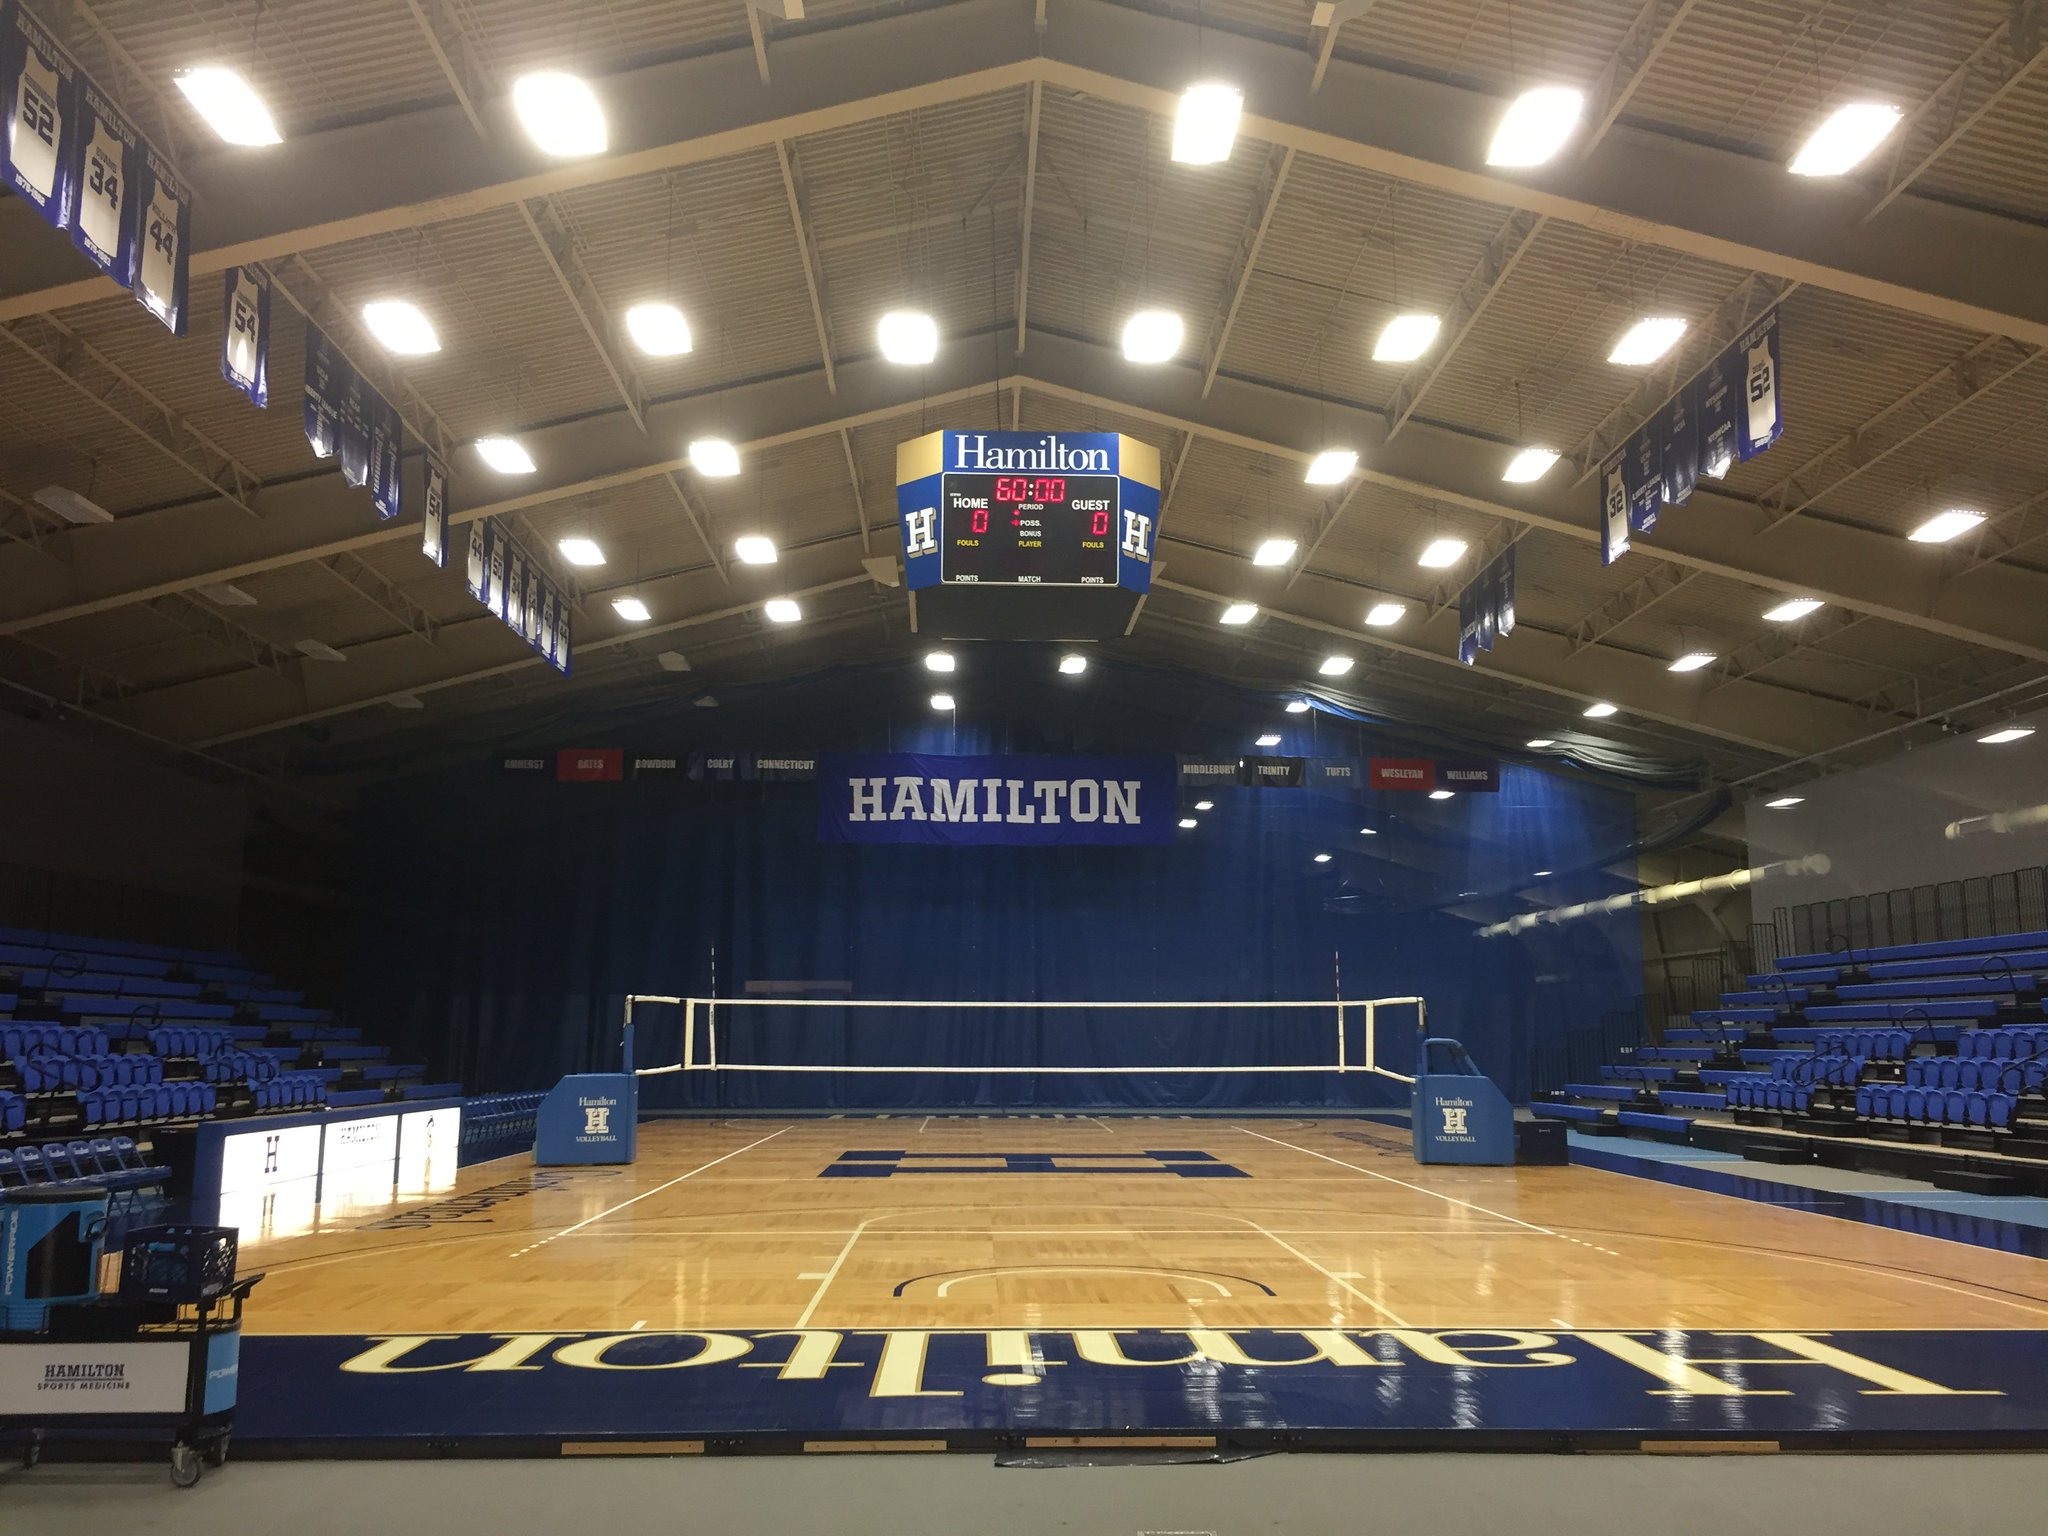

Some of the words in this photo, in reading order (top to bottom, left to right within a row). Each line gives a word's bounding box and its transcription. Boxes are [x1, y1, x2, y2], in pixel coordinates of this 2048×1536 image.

[23, 87, 54, 147] 52
[90, 157, 118, 211] 34
[150, 218, 174, 265] 44
[234, 305, 256, 343] 54
[1750, 366, 1771, 402] 52
[954, 435, 1110, 470] Hamilton
[996, 478, 1065, 502] 60:00
[953, 498, 989, 509] HOME
[1072, 500, 1110, 511] GUEST
[1609, 490, 1623, 518] 32
[972, 510, 989, 533] 0
[1020, 519, 1042, 527] POSS.
[1092, 511, 1108, 535] 0
[905, 507, 937, 558] H
[1122, 510, 1151, 562] H
[1082, 541, 1104, 549] FOULS
[1018, 575, 1042, 583] MATCH
[1081, 576, 1104, 584] POINTS
[504, 759, 545, 770] AMHERST
[635, 759, 676, 769] BOWDOIN
[707, 759, 734, 769] COLBY
[757, 759, 815, 770] CONNECTICUT
[1183, 764, 1236, 775] MIDDLEBURY
[1258, 765, 1290, 776] TRINITY
[1326, 767, 1351, 777] TUFTS
[1381, 768, 1424, 779] WESLEYAN
[1447, 770, 1488, 781] WILLIAMS
[849, 776, 1142, 824] HAMILTON
[579, 1096, 616, 1106] Hamilton
[1435, 1097, 1473, 1107] Hamilton
[585, 1108, 609, 1133] H
[1442, 1108, 1467, 1134] H
[576, 1135, 617, 1143] VOLLEYBALL
[264, 1135, 280, 1173] H
[4, 1210, 19, 1296] POWERADE
[339, 1330, 2006, 1397] Hamilton
[45, 1363, 125, 1378] HAMILTON
[37, 1382, 76, 1391] SPORTS
[79, 1382, 130, 1391] MEDICINE
